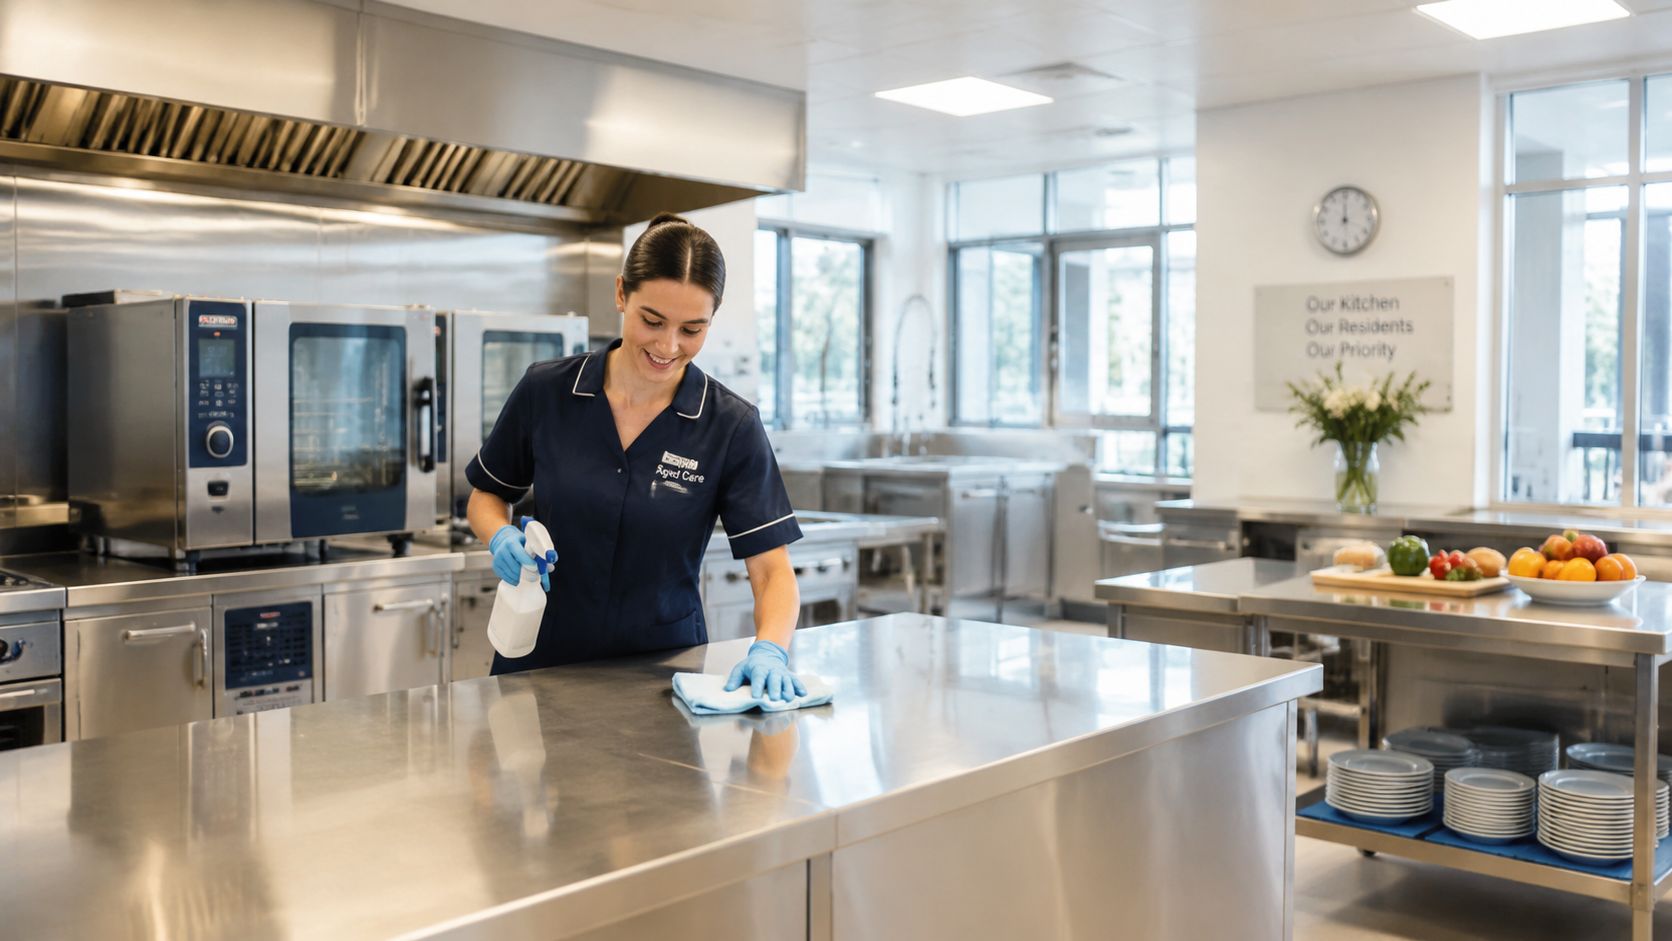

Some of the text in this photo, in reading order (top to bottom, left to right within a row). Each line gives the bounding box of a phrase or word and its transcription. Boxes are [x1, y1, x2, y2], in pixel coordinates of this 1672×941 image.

[1306, 295, 1400, 312] Our Kitchen
[1305, 318, 1414, 335] Our Residents
[1306, 341, 1397, 362] Our Priority
